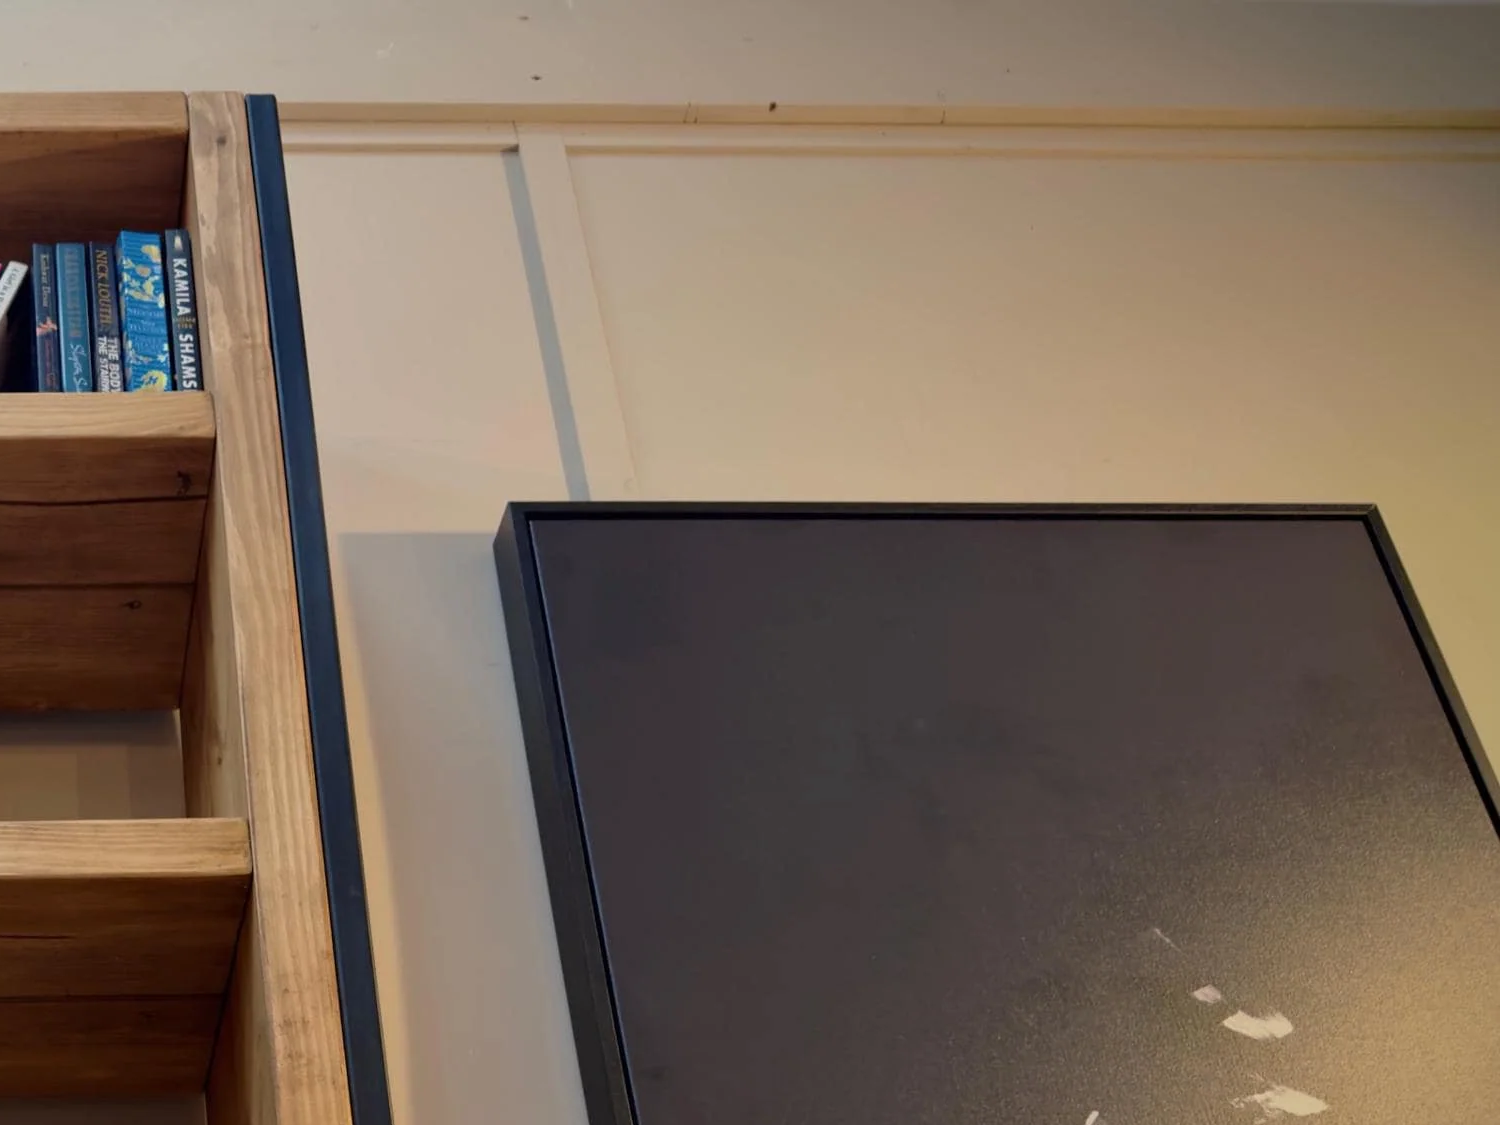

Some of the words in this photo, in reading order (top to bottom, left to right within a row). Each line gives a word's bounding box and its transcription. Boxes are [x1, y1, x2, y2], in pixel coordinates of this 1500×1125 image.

[95, 249, 108, 279] NICK
[98, 282, 112, 325] LOUTH
[172, 258, 191, 317] KAMILA
[98, 335, 108, 356] THE
[107, 337, 119, 361] THE
[179, 333, 198, 391] SHAMS
